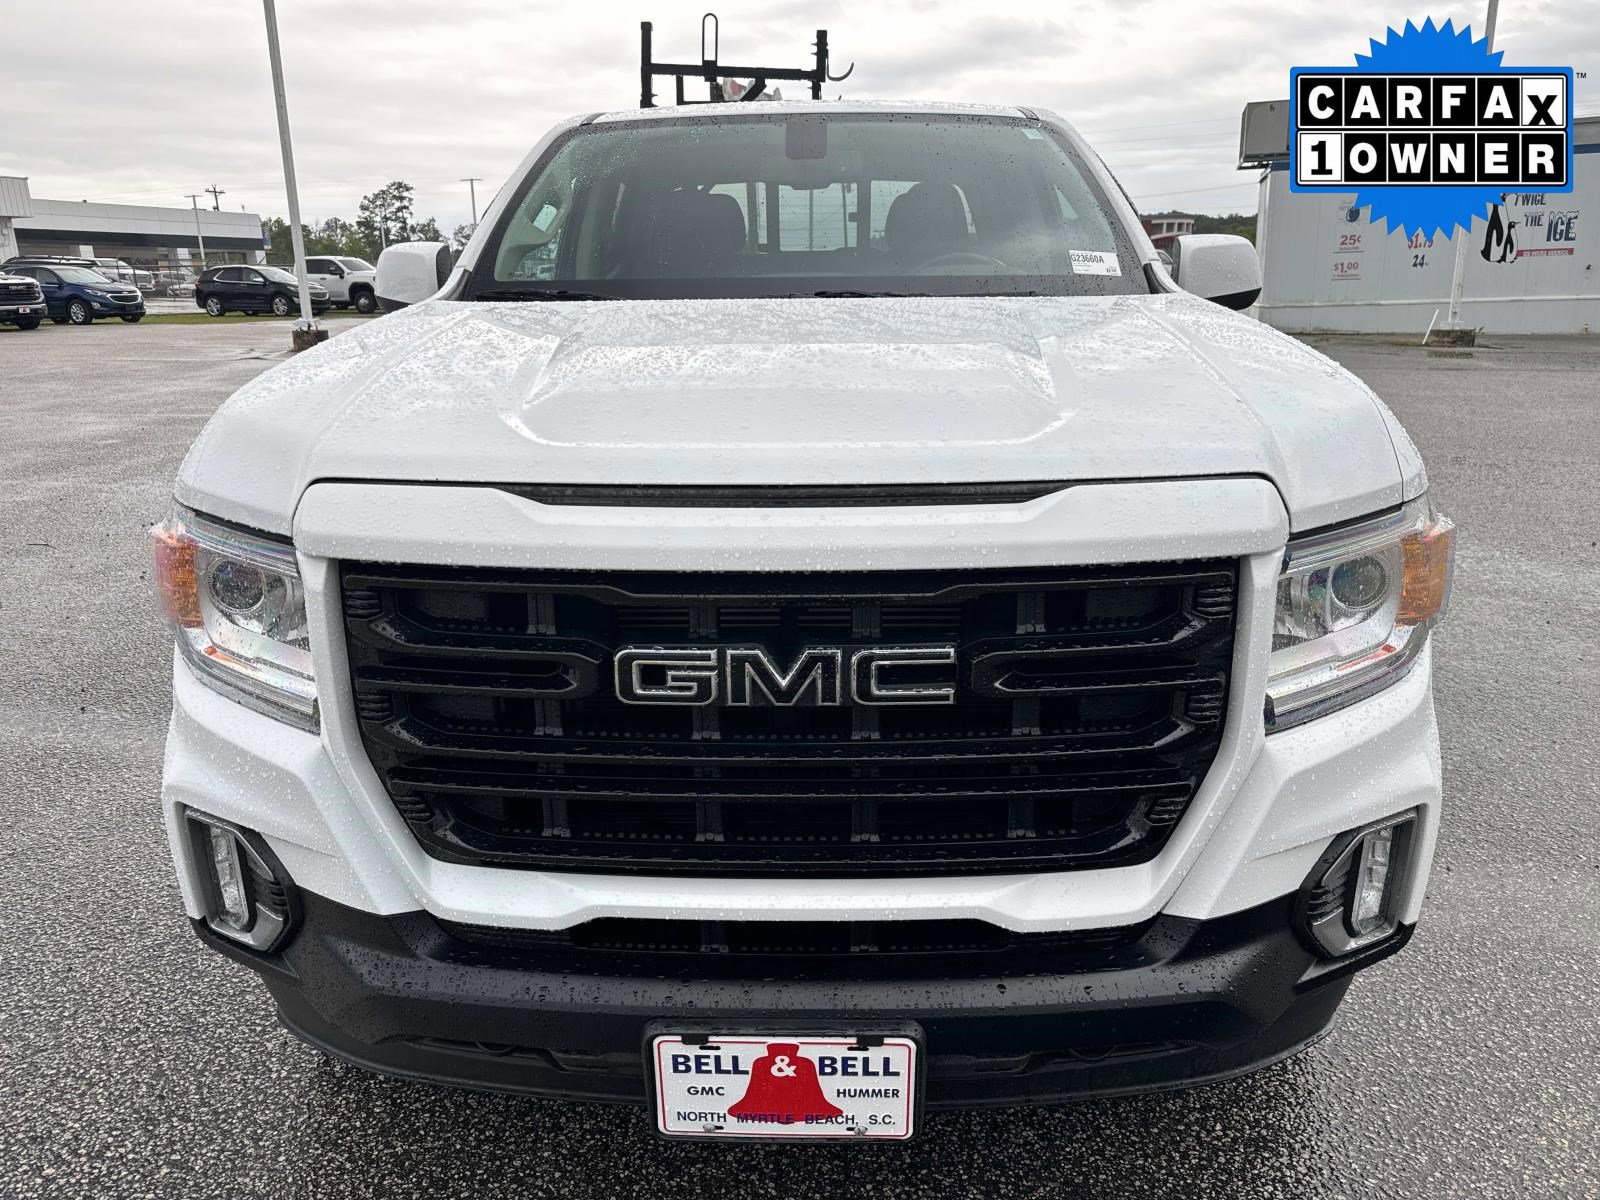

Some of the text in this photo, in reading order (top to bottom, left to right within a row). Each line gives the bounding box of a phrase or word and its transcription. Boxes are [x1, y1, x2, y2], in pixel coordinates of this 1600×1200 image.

[1515, 193, 1547, 206] TWICE
[1524, 212, 1545, 228] THE
[1546, 210, 1580, 242] ICE
[1333, 262, 1359, 274] $1.00
[614, 646, 957, 707] GMC
[671, 1054, 901, 1077] BELL & BELL
[687, 1085, 725, 1097] GMC
[836, 1088, 900, 1099] HUMMER
[676, 1111, 896, 1127] NORTH MYRTLE BEACH, S.C.
